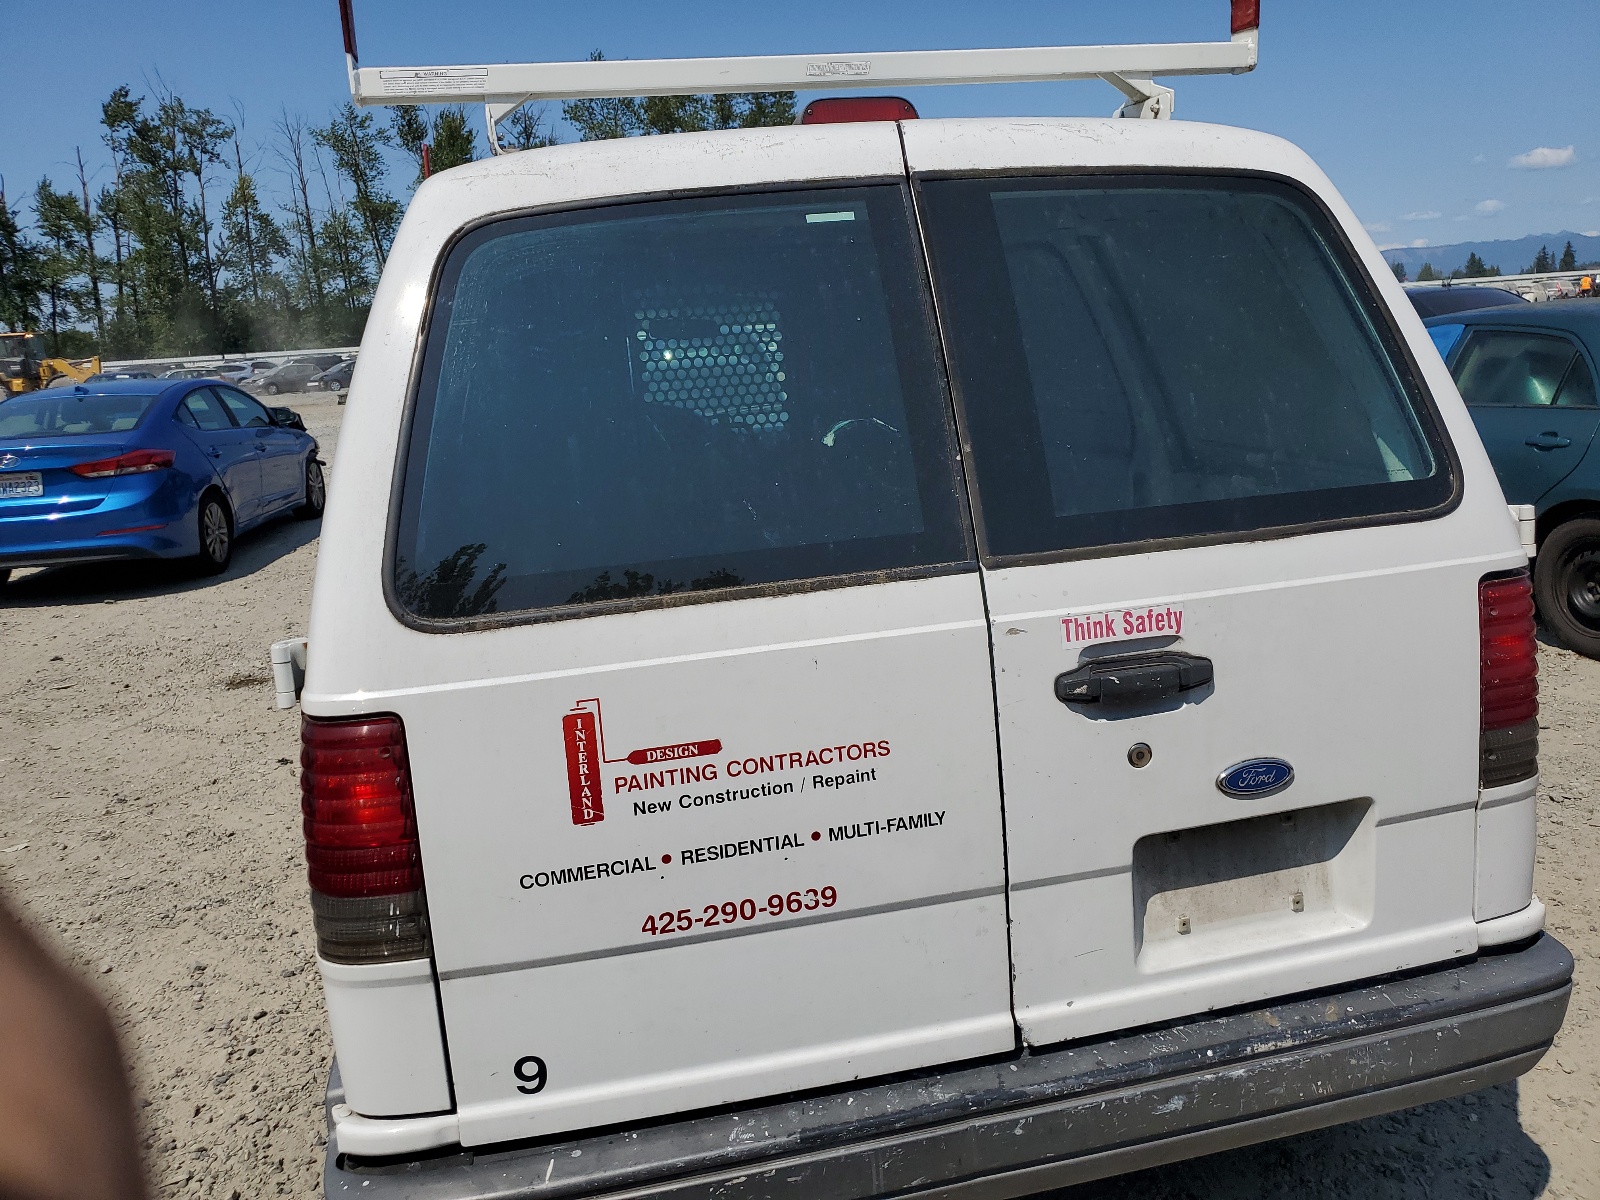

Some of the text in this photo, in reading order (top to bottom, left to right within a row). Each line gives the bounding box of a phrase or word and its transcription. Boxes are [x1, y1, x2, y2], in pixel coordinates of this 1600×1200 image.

[0, 480, 41, 495] WA2323
[1061, 607, 1183, 643] Think Safety
[574, 718, 595, 821] INTERLAND
[614, 740, 891, 795] PAINTING CONTRACTORS
[646, 744, 699, 762] DESIGN
[632, 800, 672, 817] New
[678, 783, 794, 809] Construction
[812, 770, 877, 790] Repaint
[1238, 767, 1277, 787] Ford
[519, 810, 947, 890] COMMERCIAL RESIDENTIAL MULTI-FAMILY
[641, 885, 838, 936] 425-290-9639
[513, 1055, 548, 1095] 9
